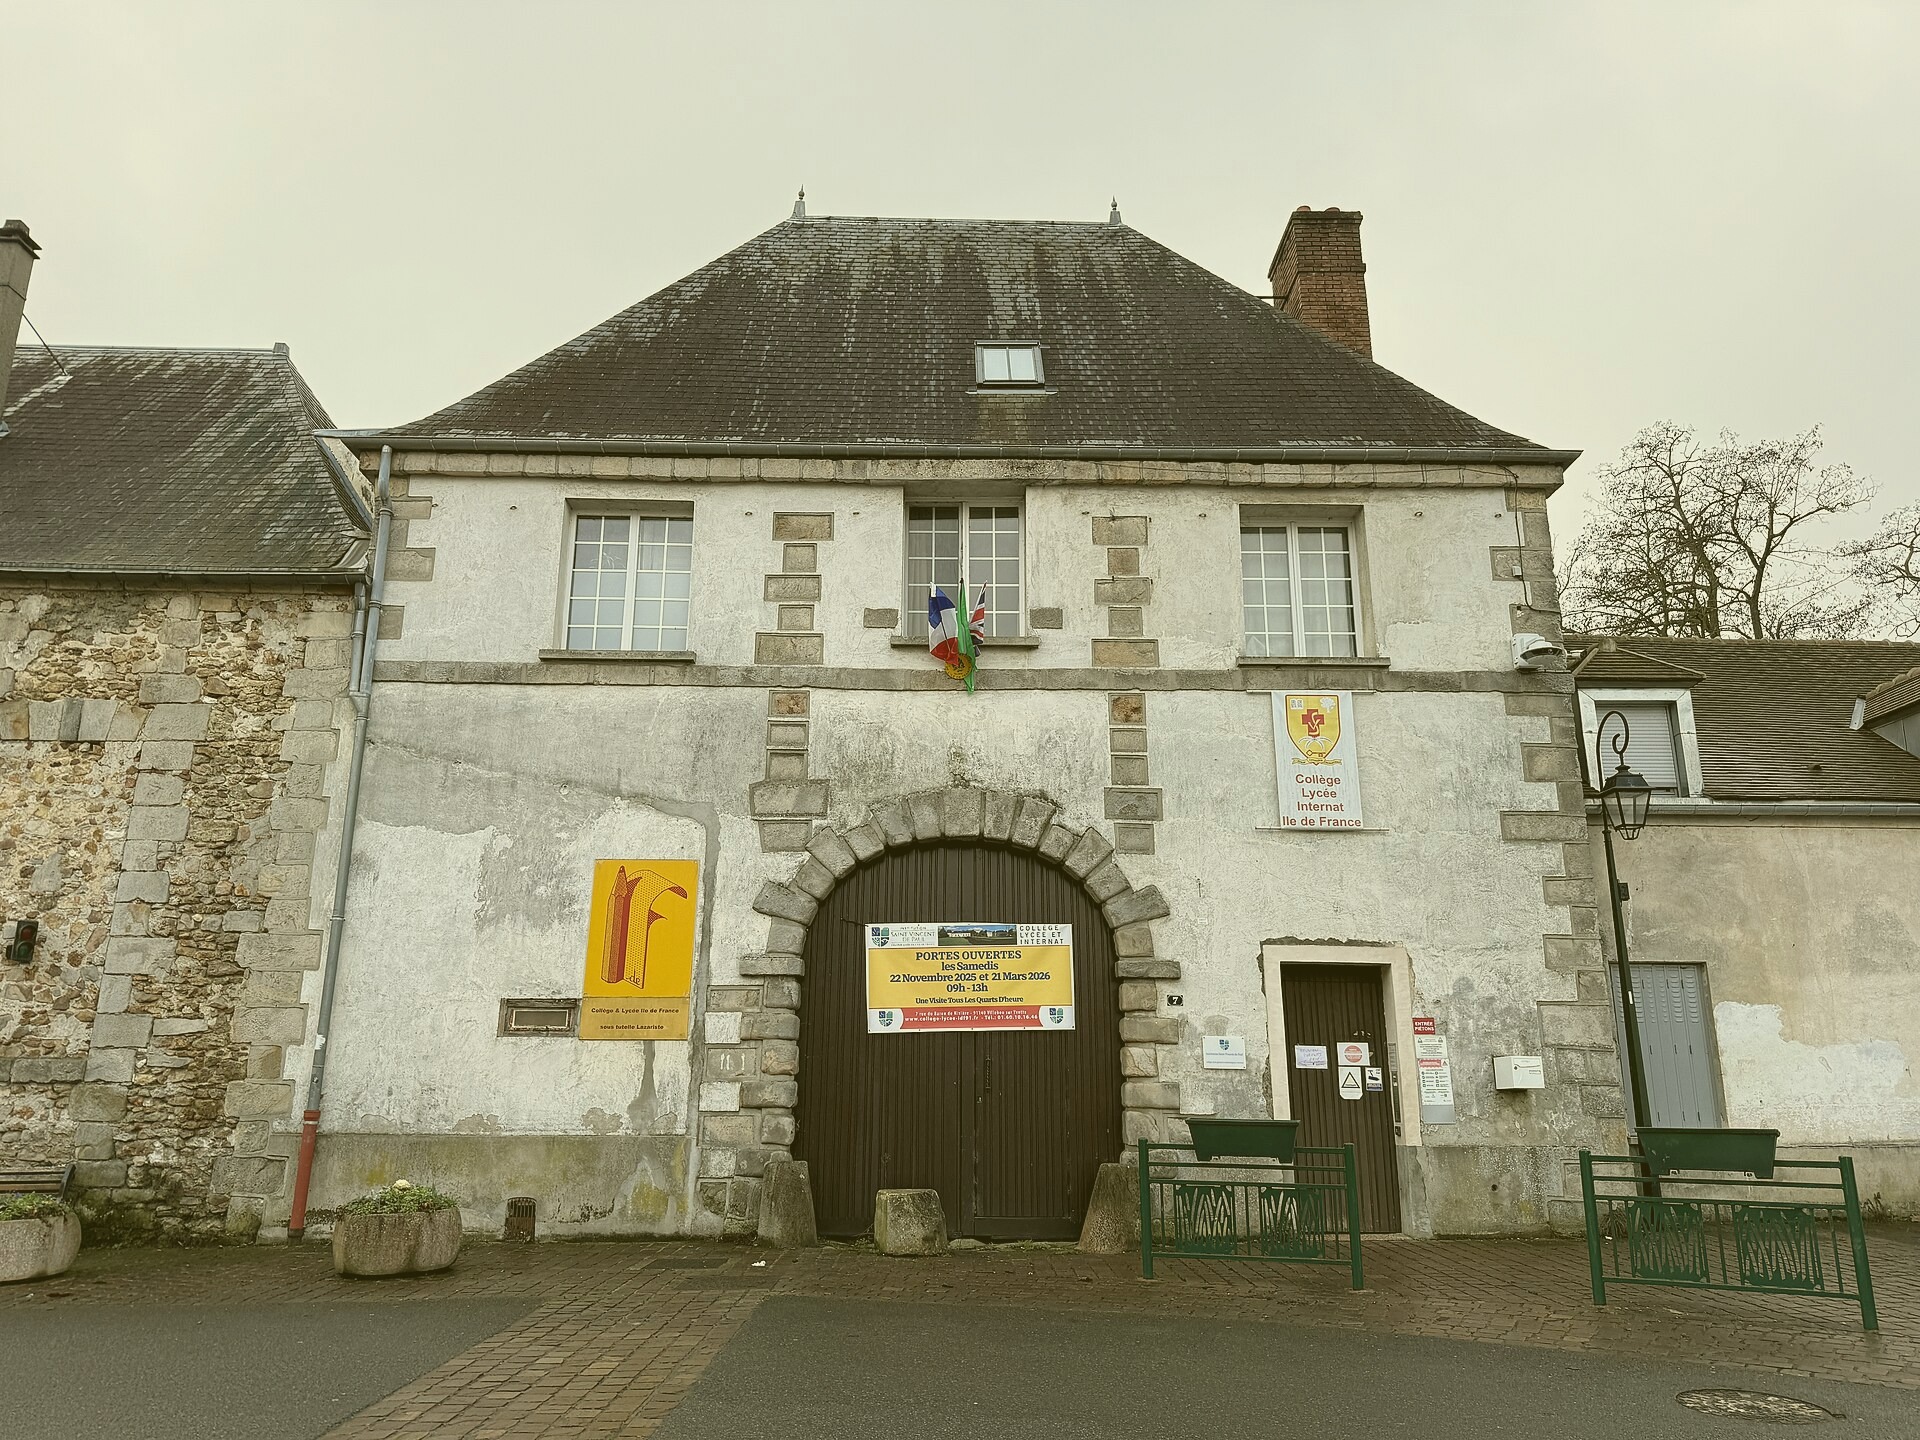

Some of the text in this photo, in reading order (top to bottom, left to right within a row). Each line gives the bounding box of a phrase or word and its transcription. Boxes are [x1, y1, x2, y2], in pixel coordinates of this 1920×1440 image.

[1295, 774, 1341, 787] Collège
[1302, 788, 1337, 800] Lycée
[1297, 801, 1344, 812] Internat
[1282, 816, 1361, 827] Ile de France
[916, 950, 1022, 960] PORTES OUVERTES
[941, 961, 999, 971] les Samedis
[889, 972, 1050, 982] 22 Novembre 2025 et 21 Mars 2026
[946, 983, 966, 992] 09h
[972, 983, 988, 992] 13h
